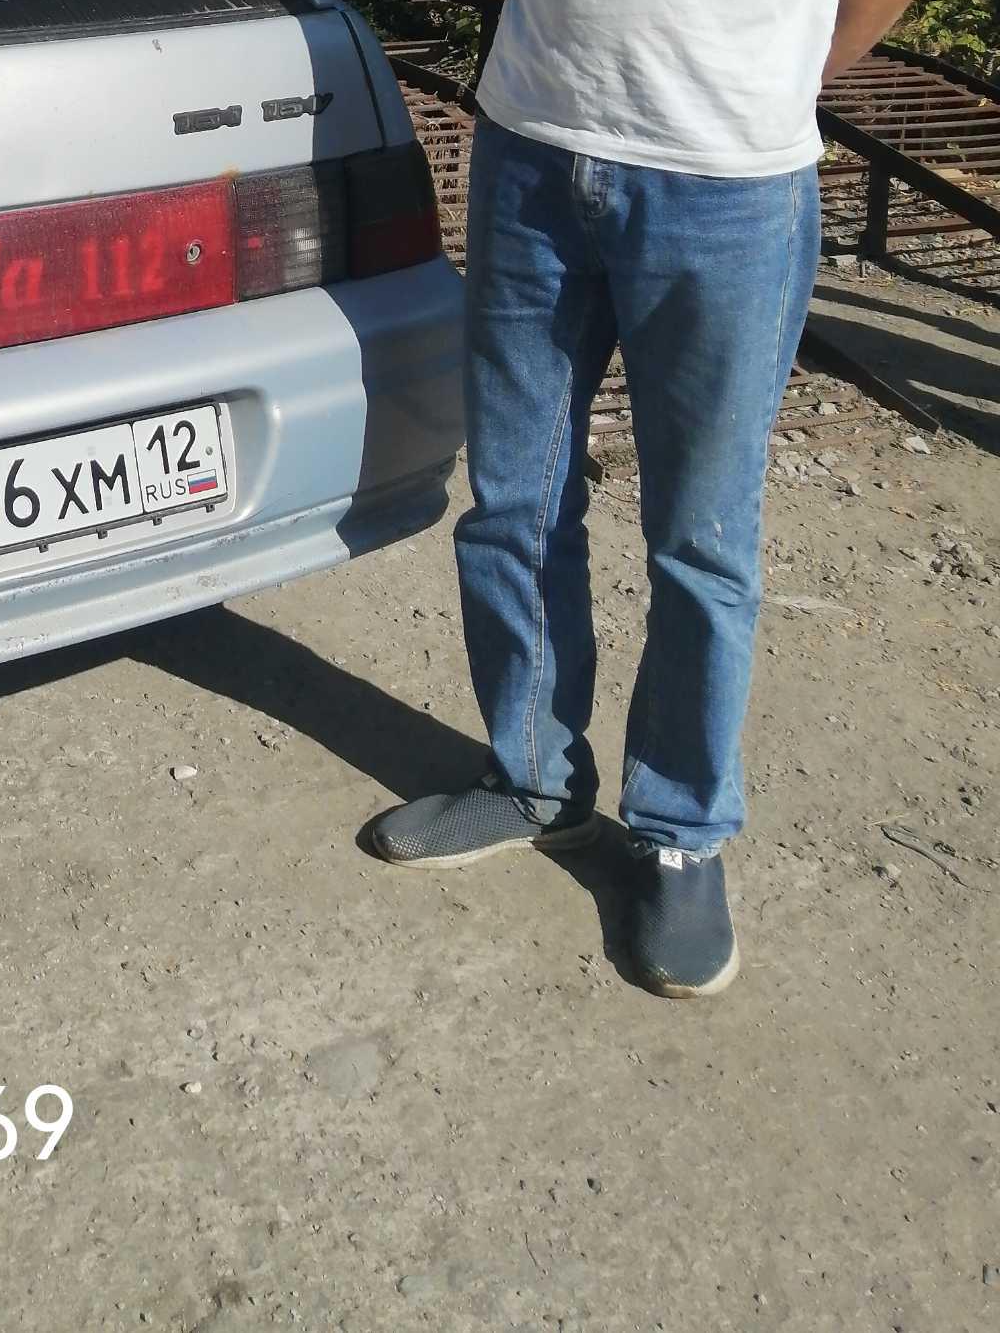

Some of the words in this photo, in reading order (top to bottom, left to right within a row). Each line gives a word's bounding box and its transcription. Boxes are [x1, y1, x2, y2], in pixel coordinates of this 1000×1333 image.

[81, 231, 167, 301] 112
[145, 419, 201, 475] 12
[145, 477, 187, 503] RUS
